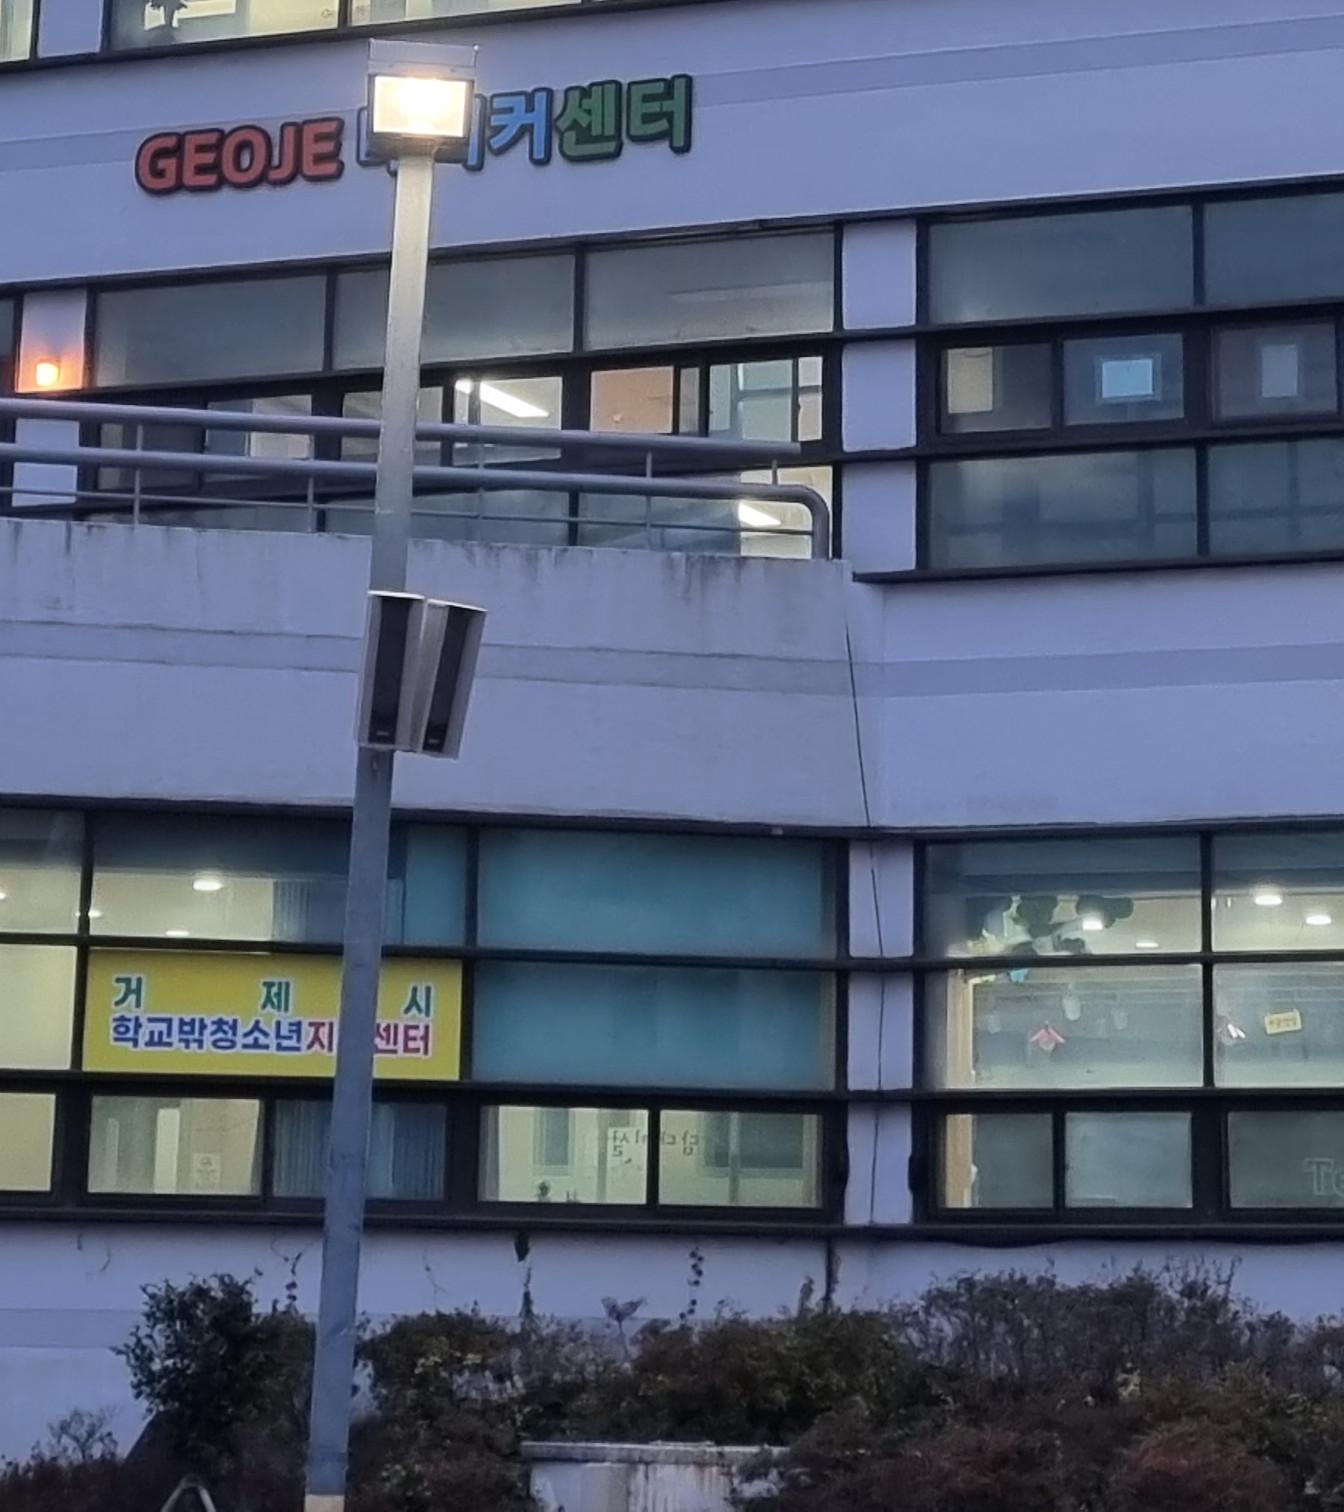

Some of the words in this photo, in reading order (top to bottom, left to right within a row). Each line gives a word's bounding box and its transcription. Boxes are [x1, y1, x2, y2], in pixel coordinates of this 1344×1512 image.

[136, 117, 344, 196] GEOJE
[356, 74, 694, 176] 커센터
[112, 1014, 432, 1057] 학교밖청소년지센터
